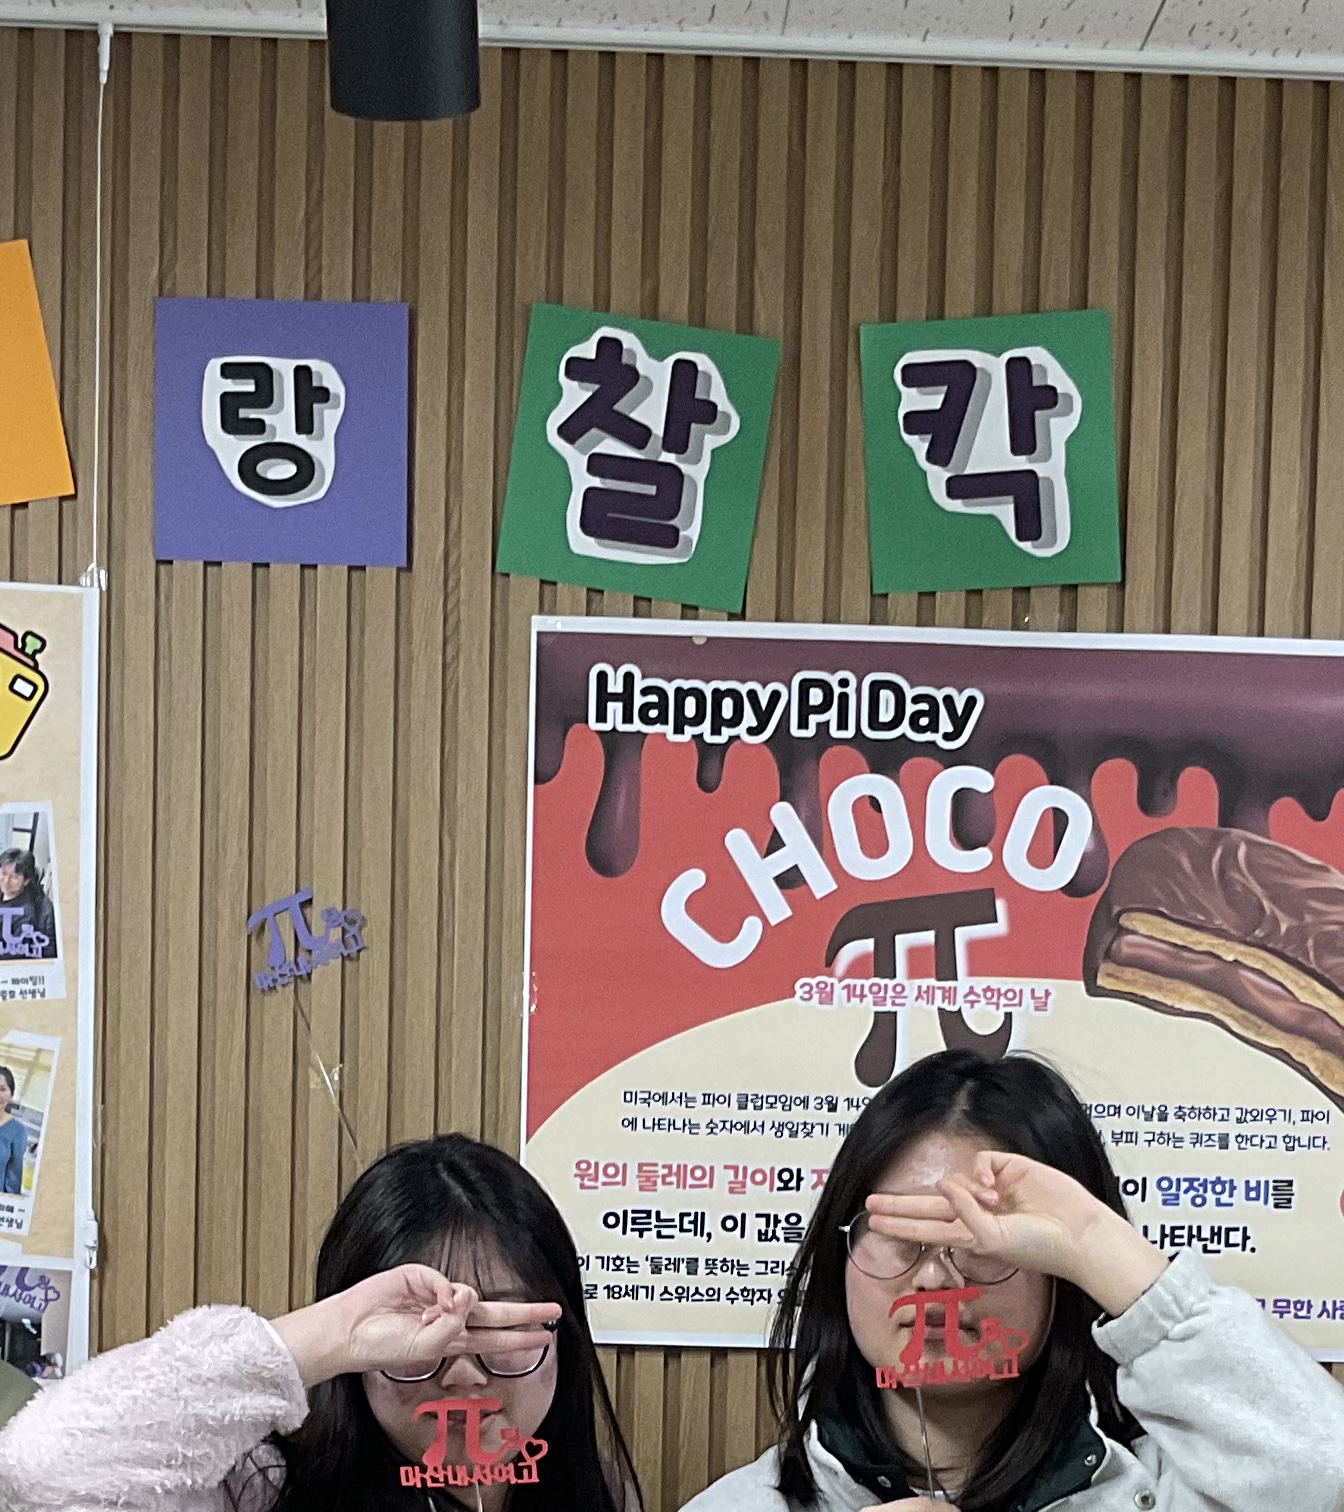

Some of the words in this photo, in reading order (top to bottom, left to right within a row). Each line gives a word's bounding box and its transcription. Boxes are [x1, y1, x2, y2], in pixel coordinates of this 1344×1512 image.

[218, 360, 332, 498] 랑
[561, 335, 722, 550] 찰
[899, 358, 1060, 548] 칵
[593, 668, 784, 738] Happy
[796, 676, 852, 733] Pi
[866, 678, 979, 744] Day
[660, 765, 1093, 969] CHOCO
[798, 980, 835, 1006] 3월
[841, 981, 907, 1007] 14일은
[913, 984, 957, 1007] 세계
[962, 985, 1023, 1011] 수학의
[1030, 987, 1052, 1012] 날
[623, 1090, 698, 1109] 미국에서는
[701, 1092, 732, 1110] 파이
[735, 1092, 810, 1112] 클럽모임에
[813, 1094, 839, 1113] 3월
[1125, 1103, 1170, 1122] 이날을
[1173, 1105, 1231, 1123] 축하하고
[1299, 1109, 1331, 1125] 파이
[621, 1116, 638, 1133] 에
[642, 1117, 702, 1136] 나타나는
[705, 1118, 765, 1137] 숫자에서
[769, 1120, 830, 1139] 생일찾기
[1110, 1129, 1139, 1148] 부피
[1143, 1131, 1186, 1150] 구하는
[1188, 1132, 1231, 1150] 퀴즈를
[1234, 1132, 1278, 1151] 한다고
[1282, 1133, 1331, 1152] 합니다.
[573, 1158, 628, 1191] 원의
[635, 1161, 715, 1192] 둘레의
[722, 1163, 804, 1195] 길이와
[1155, 1175, 1238, 1208] 일정한
[1244, 1178, 1296, 1210] 비를
[602, 1208, 713, 1243] 이루는데,
[720, 1212, 747, 1239] 이
[754, 1212, 807, 1244] 값을
[1142, 1223, 1257, 1255] 나타낸다.
[594, 1255, 641, 1275] 기호는
[704, 1257, 751, 1277] 뜻하는
[602, 1284, 655, 1302] 18세기
[659, 1285, 722, 1303] 스위스의
[724, 1286, 774, 1306] 수학자
[1271, 1297, 1314, 1320] 무한
